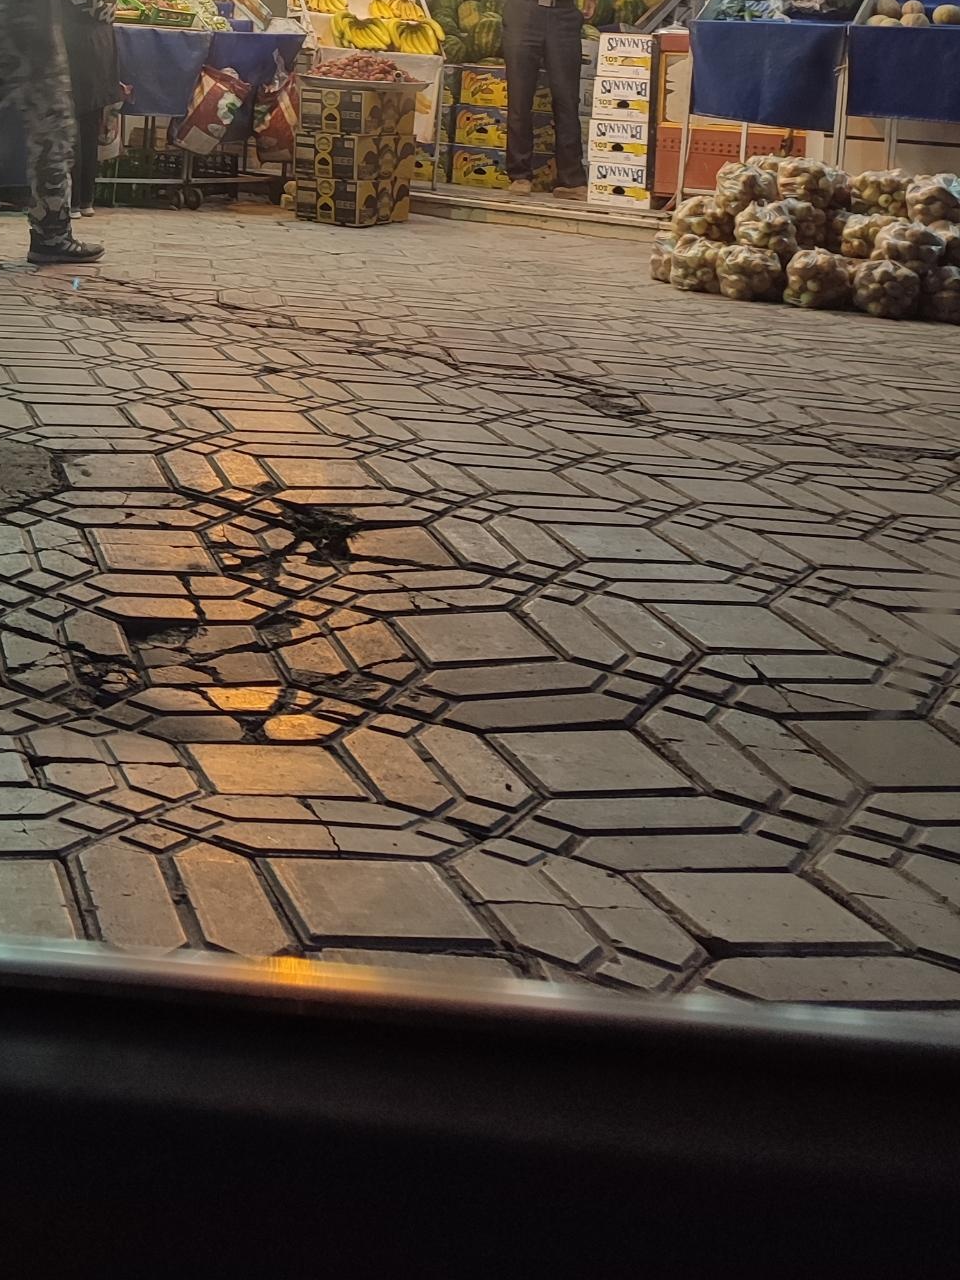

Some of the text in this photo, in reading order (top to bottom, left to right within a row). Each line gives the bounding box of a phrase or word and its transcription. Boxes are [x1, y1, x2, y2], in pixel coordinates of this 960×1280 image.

[607, 37, 653, 55] BANANAS
[601, 80, 648, 97] BANANAS
[596, 122, 643, 141] BANANAS
[596, 165, 645, 185] BANANAS
